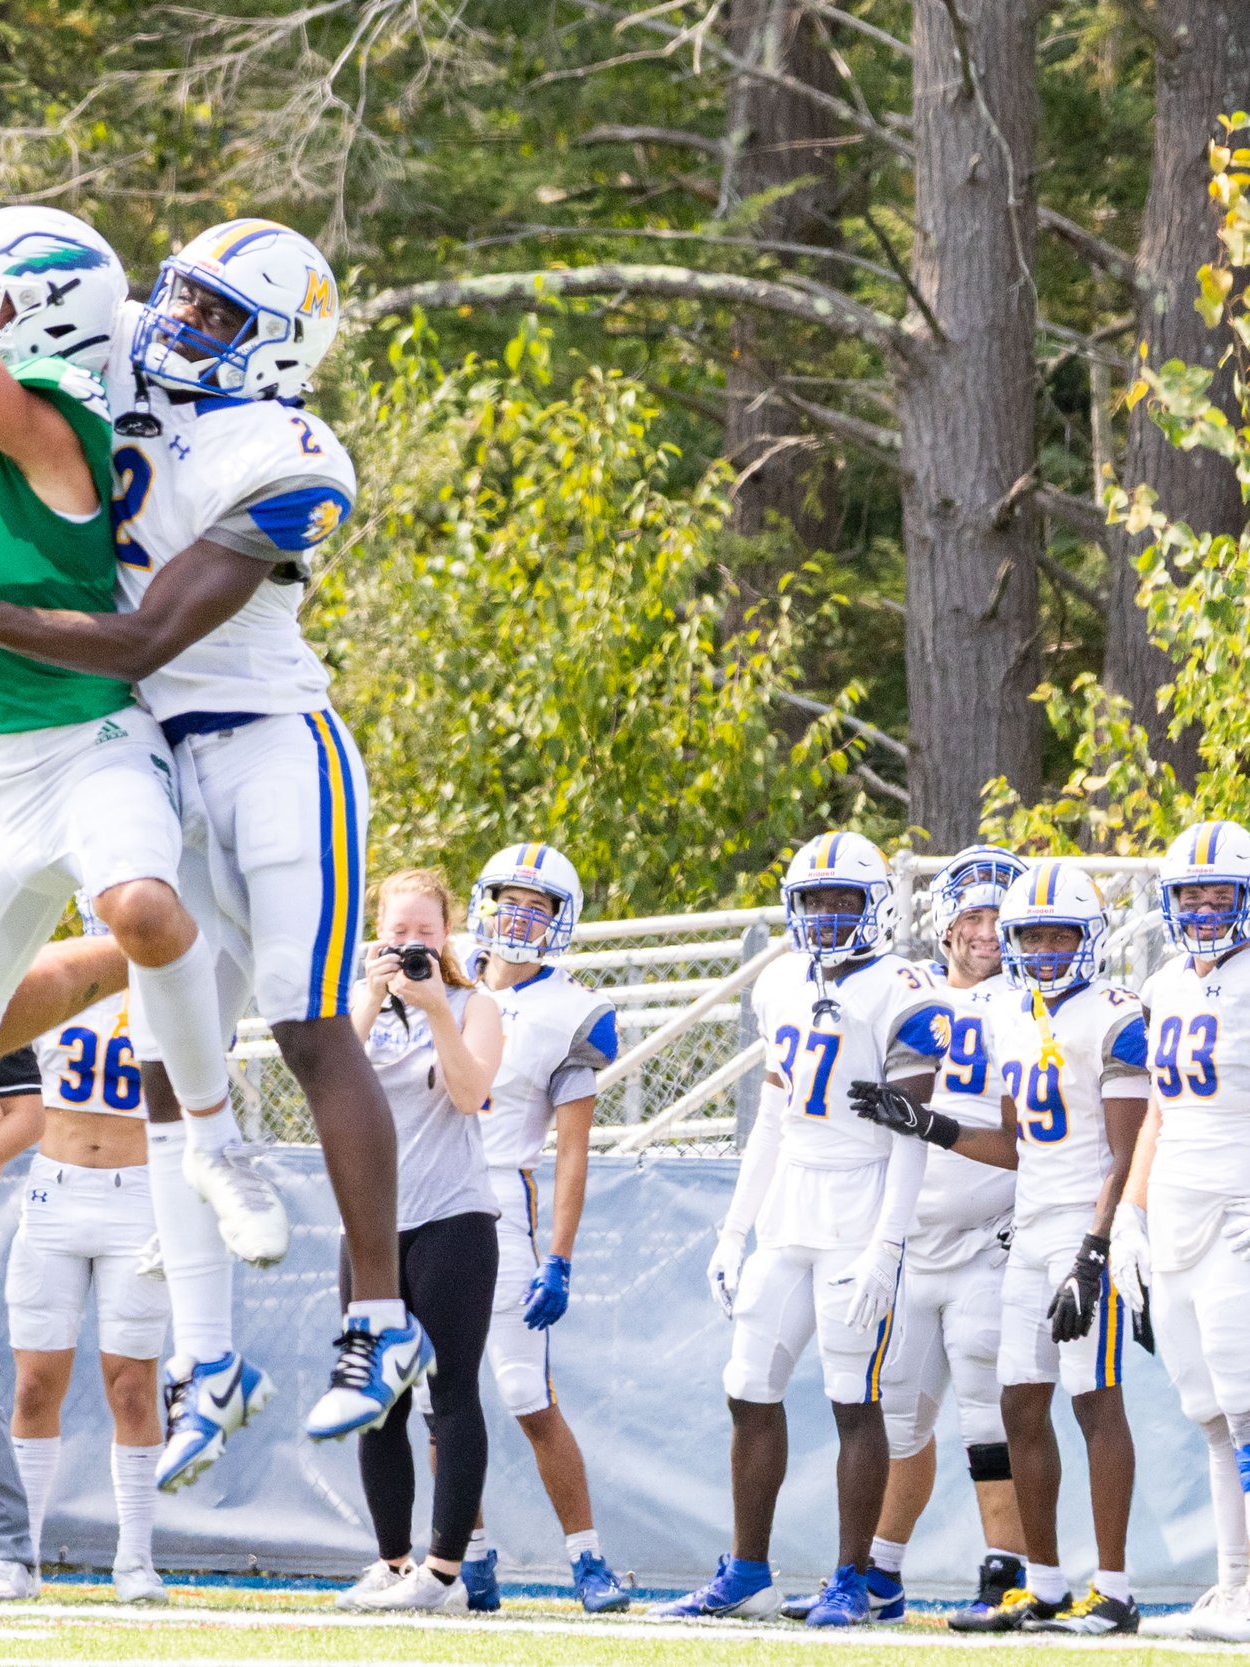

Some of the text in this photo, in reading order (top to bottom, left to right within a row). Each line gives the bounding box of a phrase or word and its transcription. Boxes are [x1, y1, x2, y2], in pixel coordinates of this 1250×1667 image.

[290, 416, 325, 456] 2
[111, 444, 156, 572] 2
[57, 1023, 145, 1114] 36
[1153, 1011, 1221, 1101] 93
